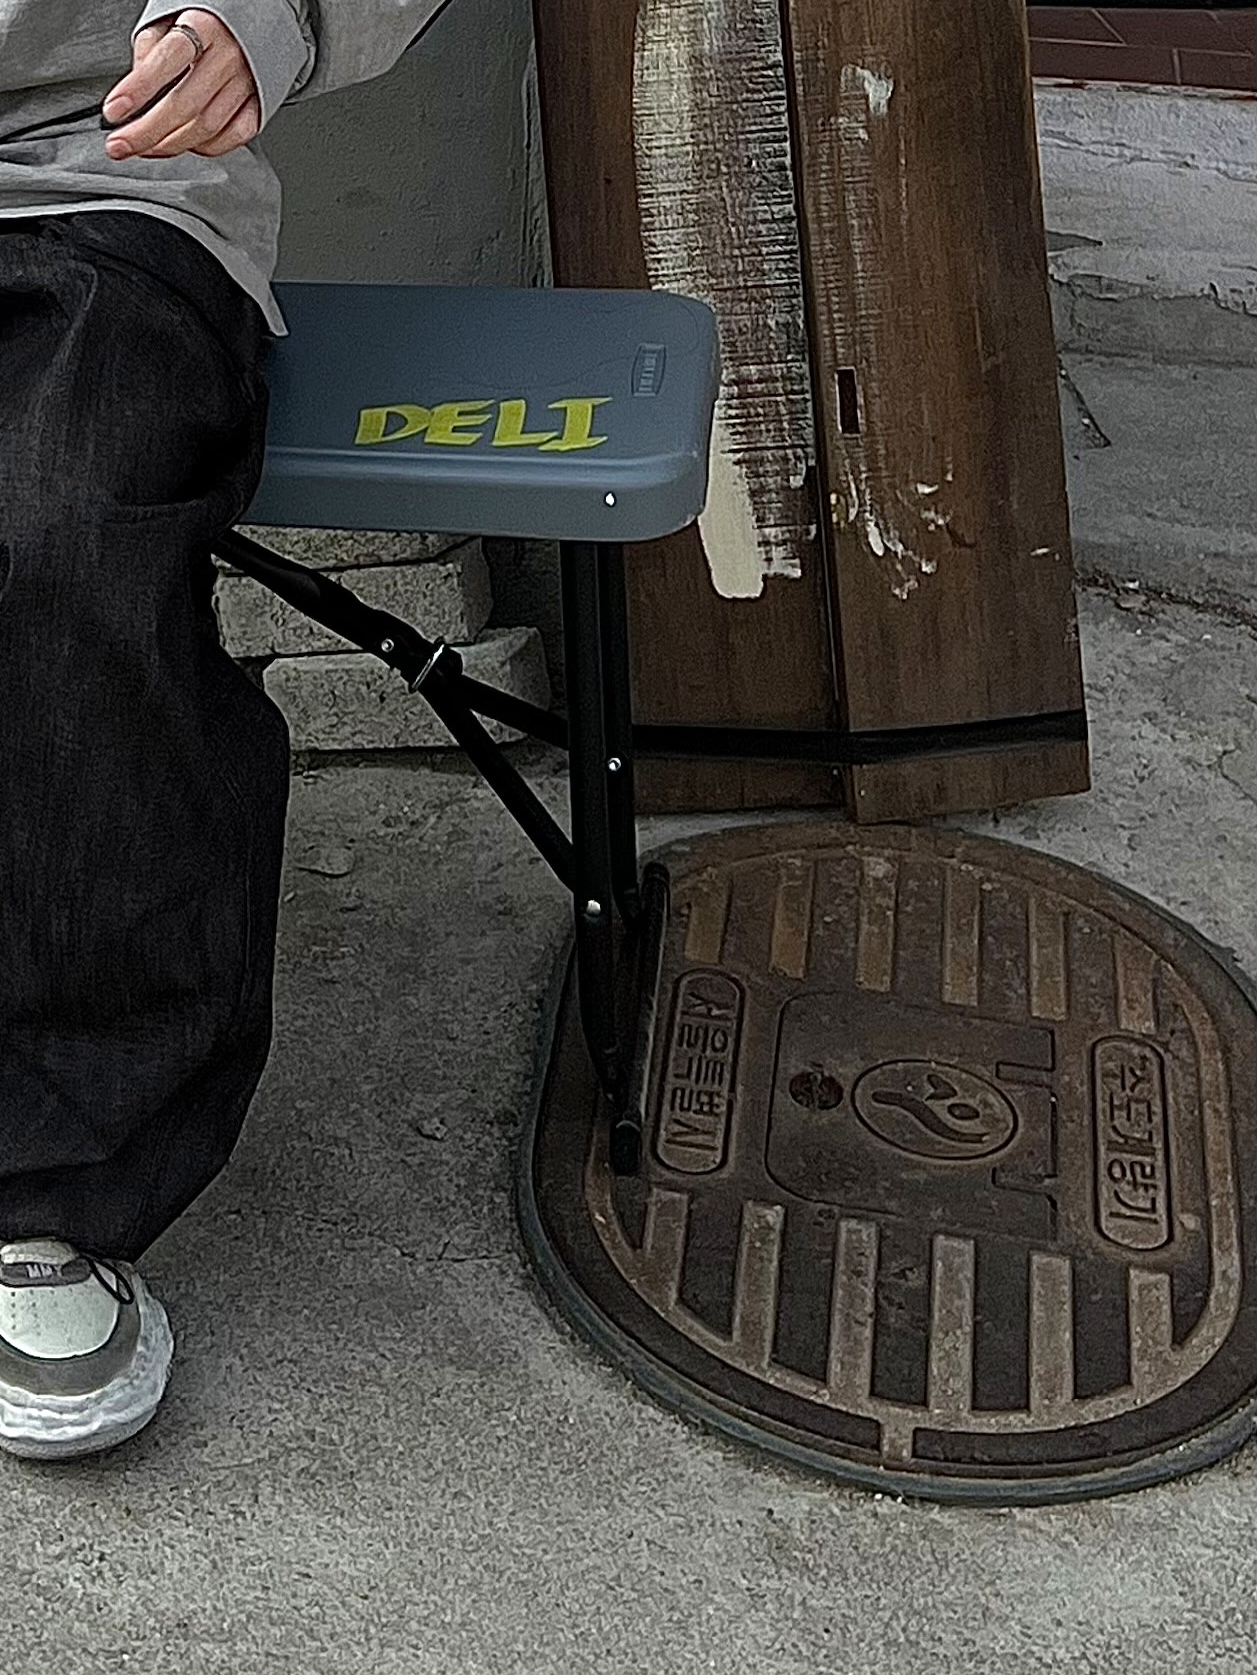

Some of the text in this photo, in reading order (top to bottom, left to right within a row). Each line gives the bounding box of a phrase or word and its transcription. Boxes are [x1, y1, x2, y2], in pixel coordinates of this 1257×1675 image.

[355, 396, 614, 452] DELI
[664, 990, 735, 1153] 서울특별시
[1107, 1062, 1161, 1226] 수도계량기
